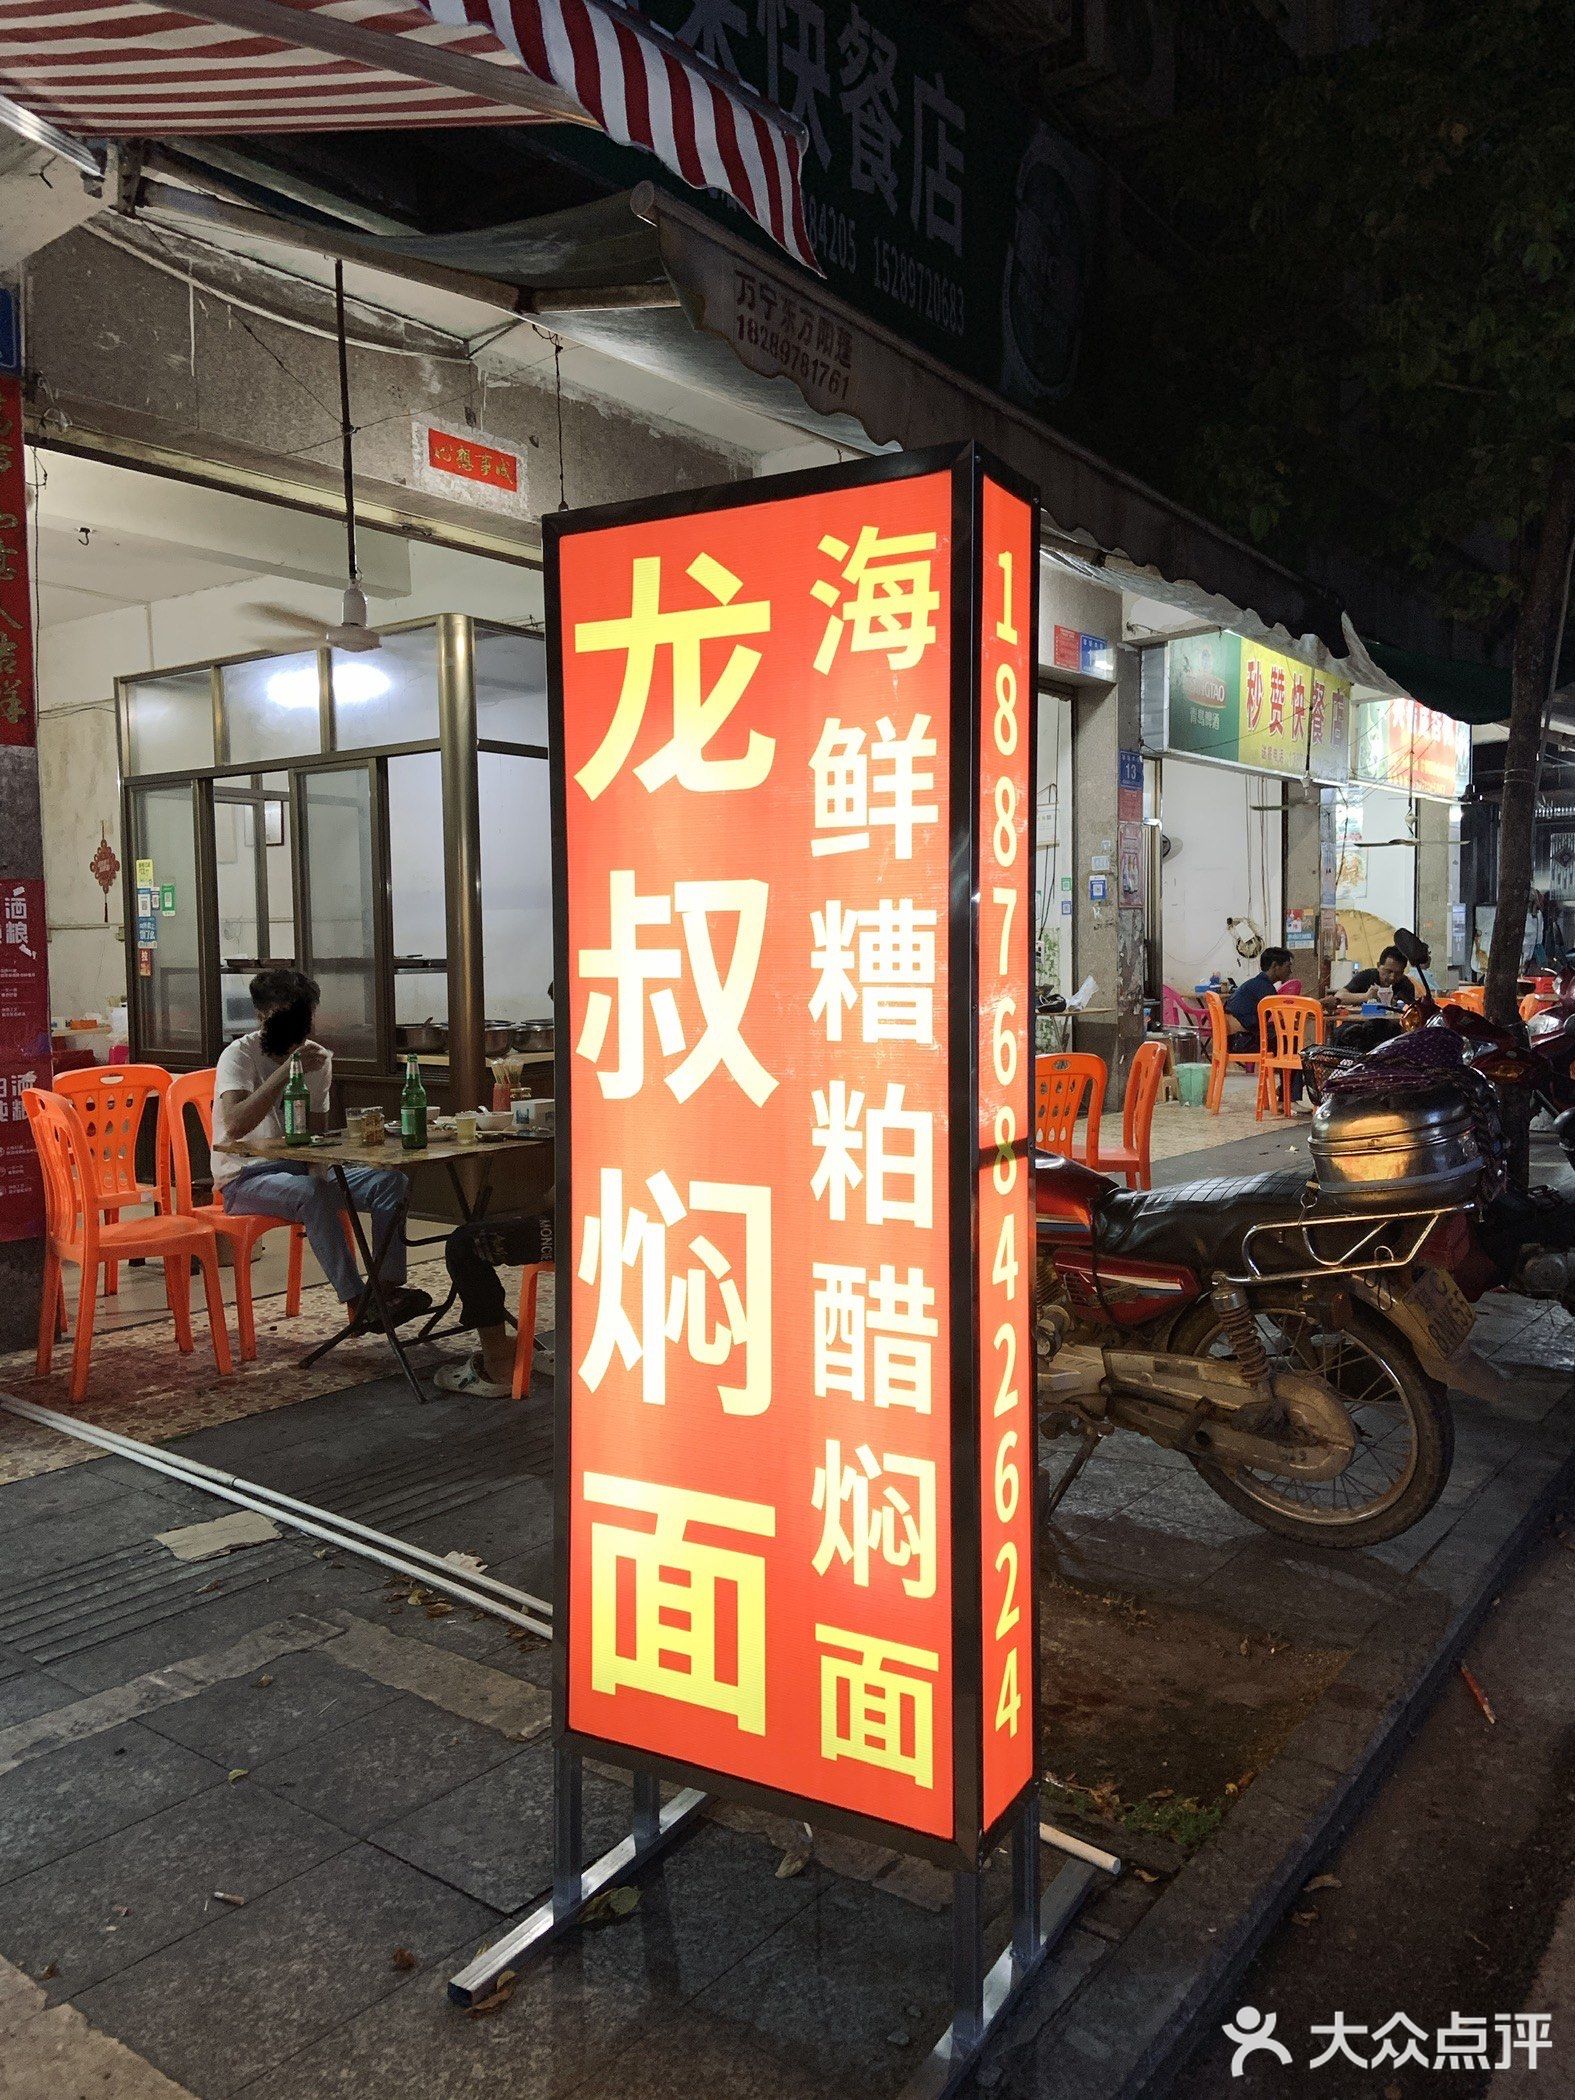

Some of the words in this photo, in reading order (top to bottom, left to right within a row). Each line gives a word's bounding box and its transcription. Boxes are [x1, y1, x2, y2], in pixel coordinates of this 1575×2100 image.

[434, 443, 514, 485] 心想事成
[805, 194, 857, 274] 84205
[1125, 763, 1137, 780] 13
[574, 551, 780, 1737] 龙叔焖面
[807, 525, 941, 1790] 海鲜糟粕醋焖面
[991, 550, 1021, 1738] 18876842624
